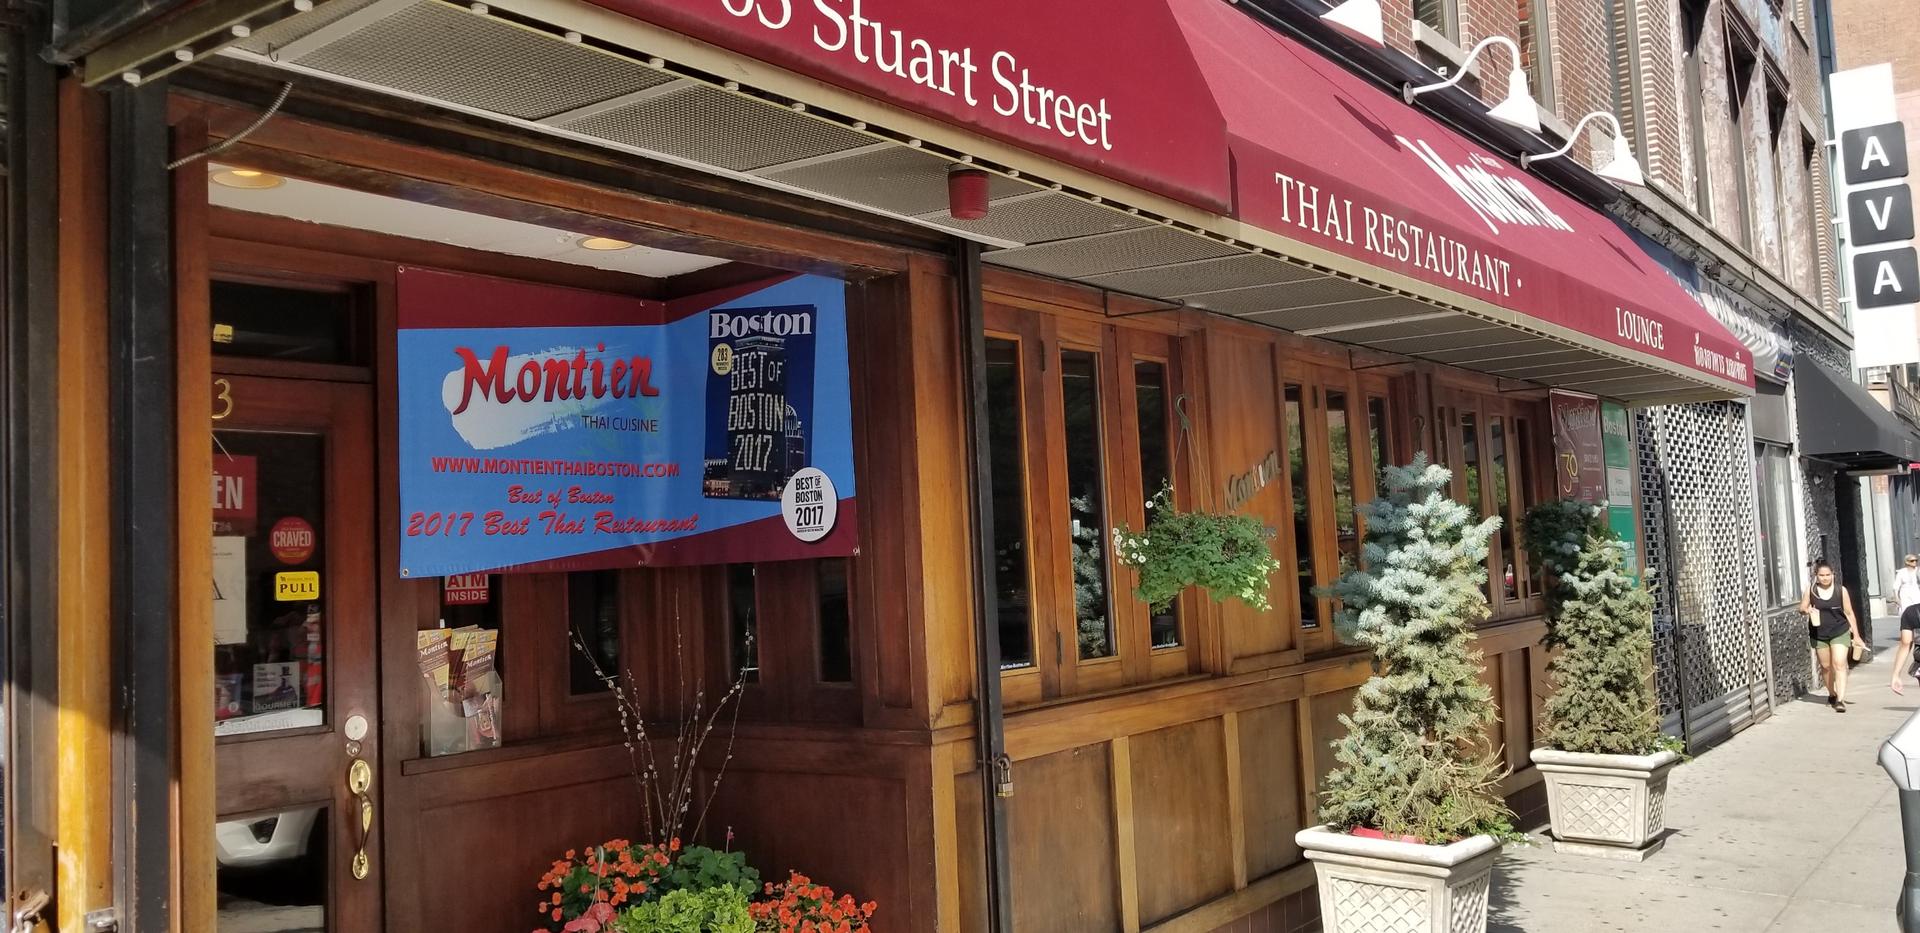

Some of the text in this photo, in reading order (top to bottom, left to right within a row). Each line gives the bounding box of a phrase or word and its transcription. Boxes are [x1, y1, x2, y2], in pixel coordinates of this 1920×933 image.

[813, 0, 1112, 151] Stuart Street
[1861, 136, 1902, 296] AVA
[1275, 172, 1510, 297] THAI RESTAURANT
[710, 311, 812, 338] Boston
[1615, 307, 1664, 350] LOUNGE
[453, 342, 660, 415] Montien
[731, 351, 784, 391] BEST OF
[582, 415, 658, 432] THAI CUISINE
[728, 393, 784, 432] BOSTON
[735, 434, 773, 471] 2017
[432, 457, 680, 477] WWW.MONTIENTHAIBOSTON.COM
[508, 484, 615, 508] Best of Boston
[796, 477, 822, 490] BEST OF
[796, 490, 823, 503] BOSTON
[407, 509, 700, 537] 2017 Best Thai Restaurant
[796, 506, 824, 526] 2017
[273, 530, 312, 547] CRAVED
[280, 583, 315, 593] PULL
[447, 574, 487, 588] ATM
[447, 590, 487, 601] INSIDE
